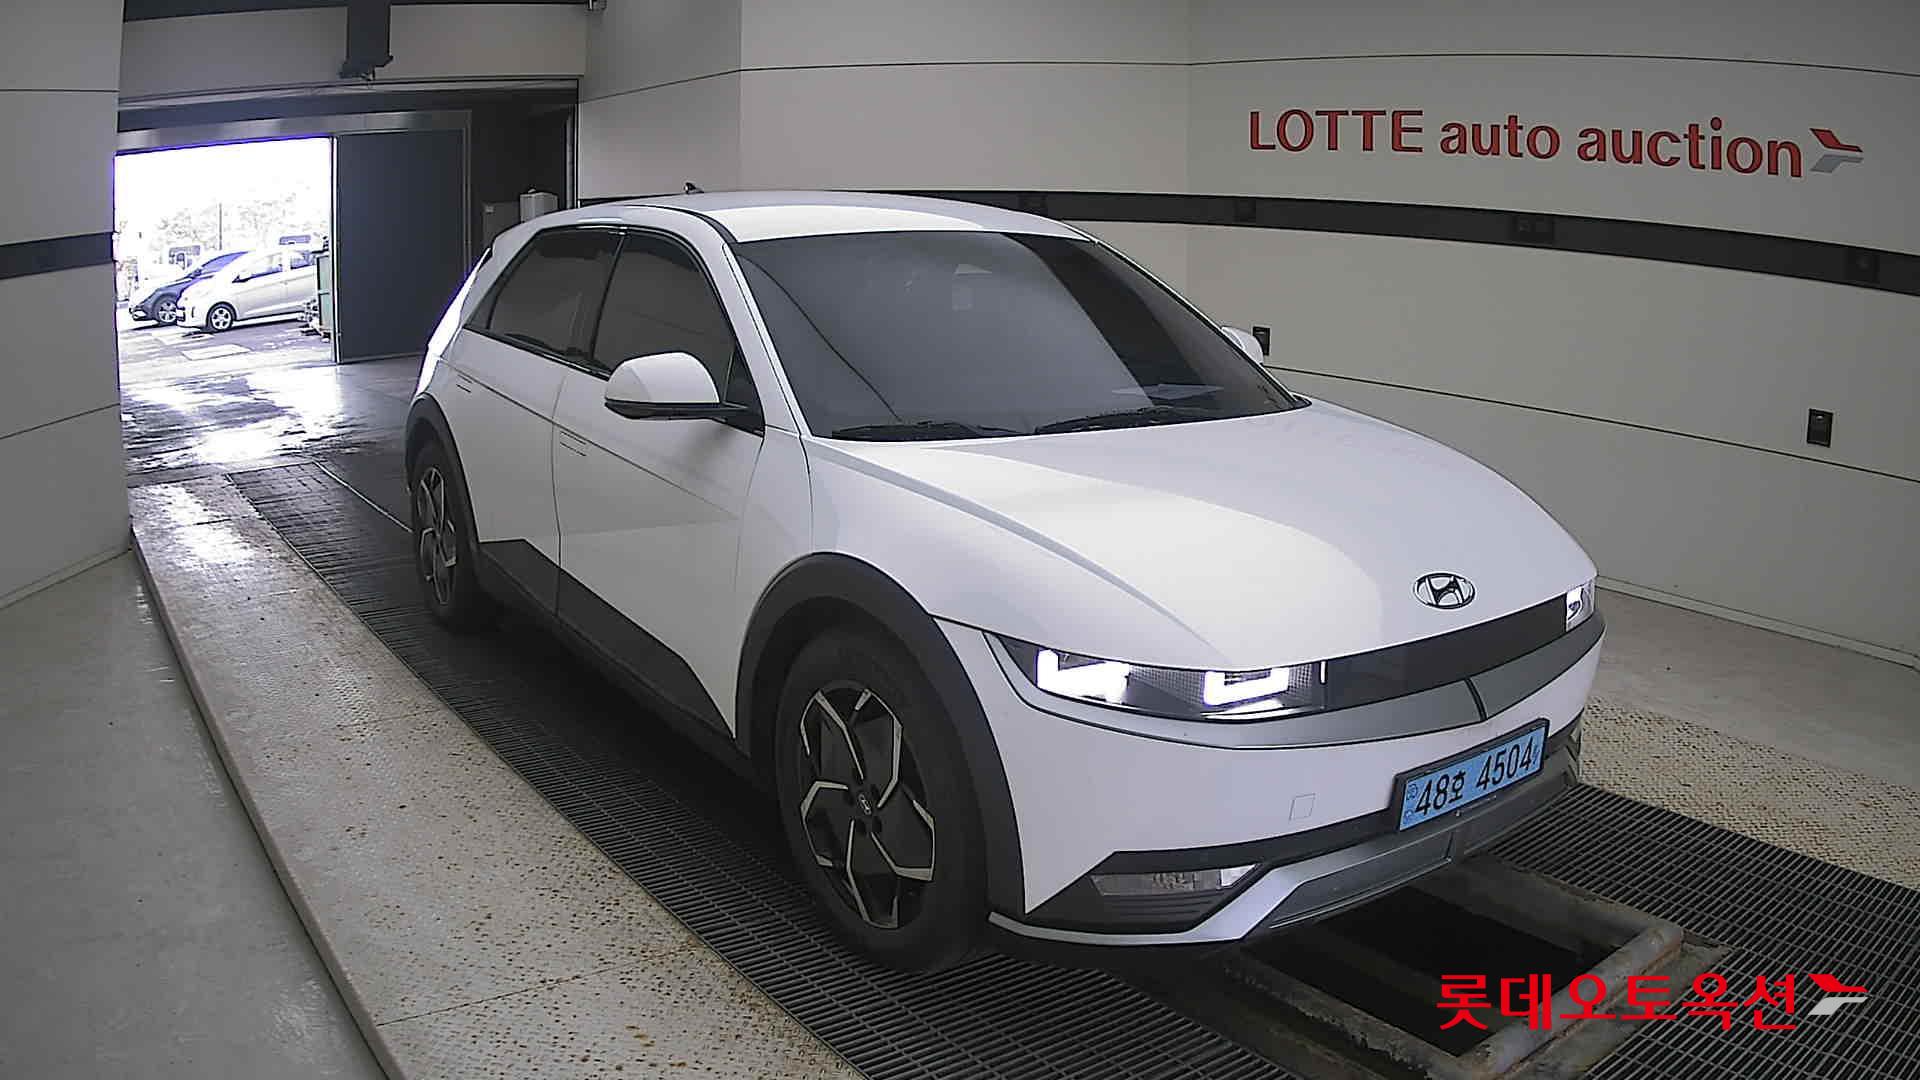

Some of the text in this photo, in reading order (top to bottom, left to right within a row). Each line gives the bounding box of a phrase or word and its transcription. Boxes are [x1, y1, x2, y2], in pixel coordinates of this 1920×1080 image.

[1249, 109, 1802, 178] LOTTE auto auction
[1415, 735, 1534, 816] 48호 4504
